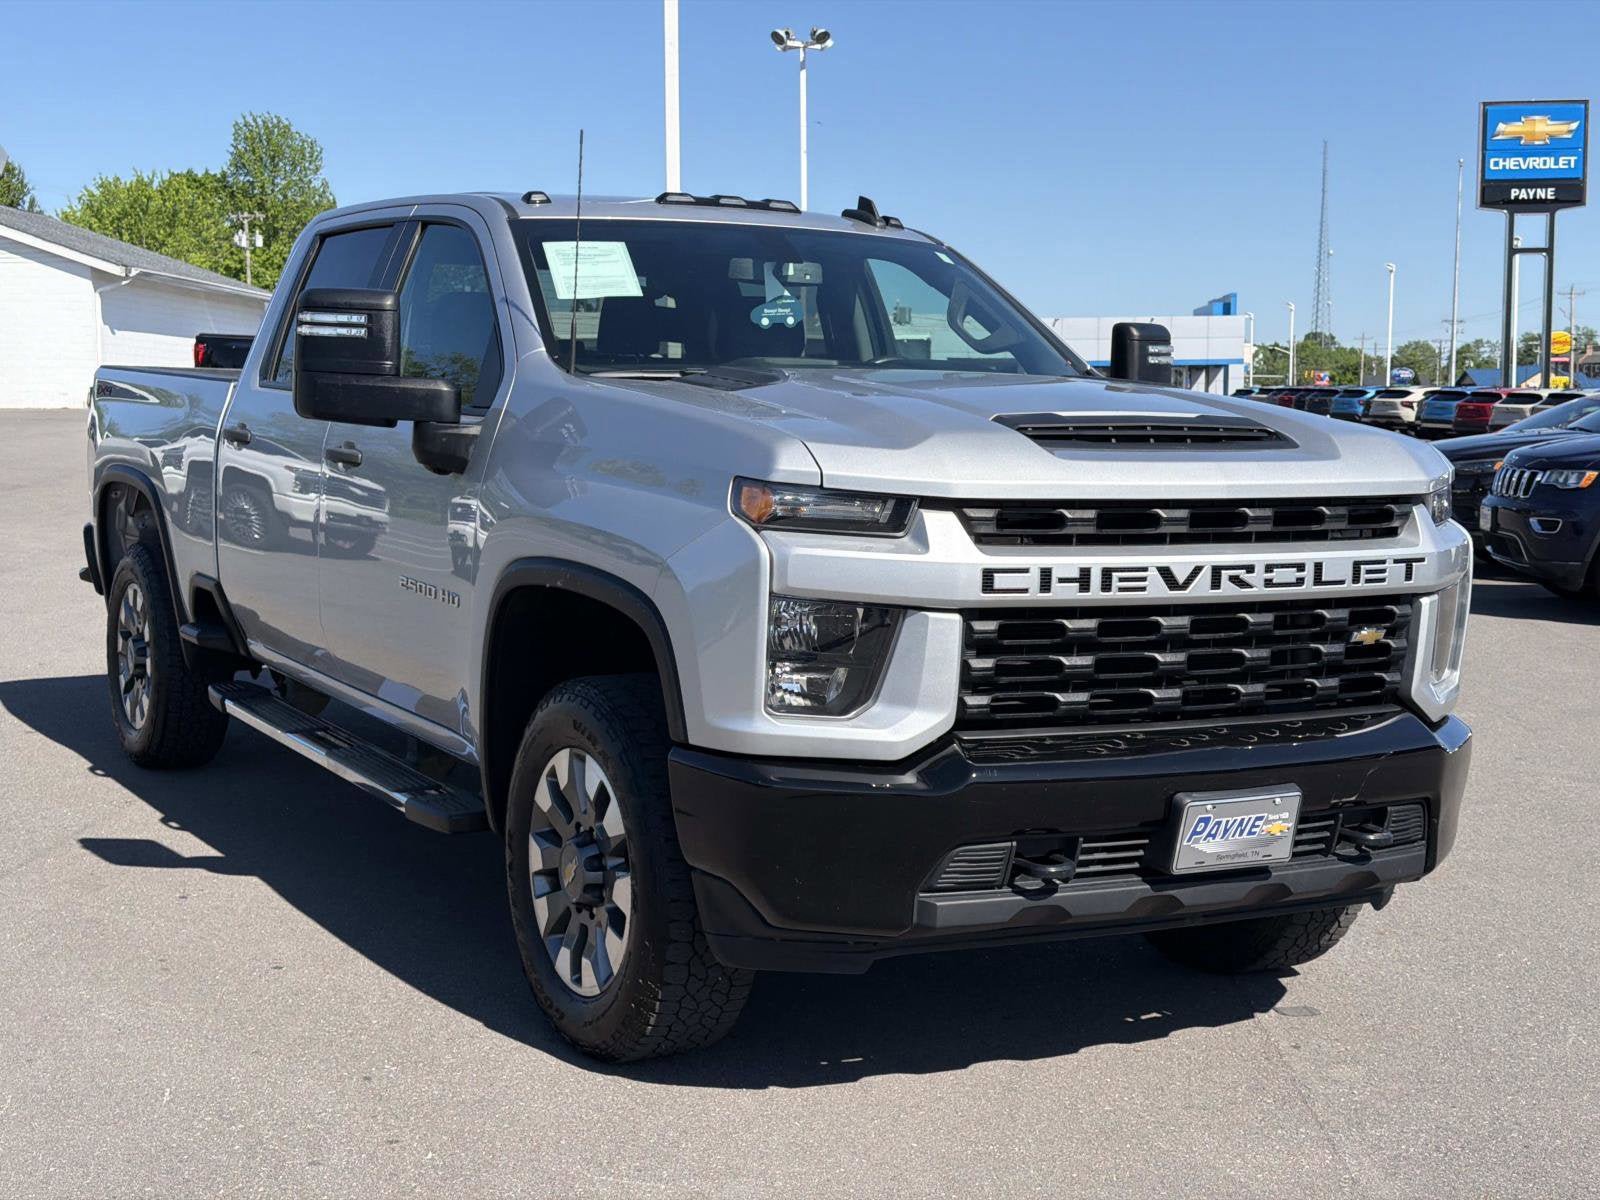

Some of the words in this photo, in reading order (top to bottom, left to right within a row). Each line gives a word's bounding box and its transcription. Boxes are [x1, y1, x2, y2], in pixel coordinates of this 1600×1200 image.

[1489, 156, 1578, 170] CHEVROLET
[1510, 187, 1556, 200] PAYNE
[399, 575, 438, 600] 2500
[440, 588, 460, 608] HD
[980, 556, 1427, 595] CHEVROLET
[1184, 813, 1268, 845] PAYNE
